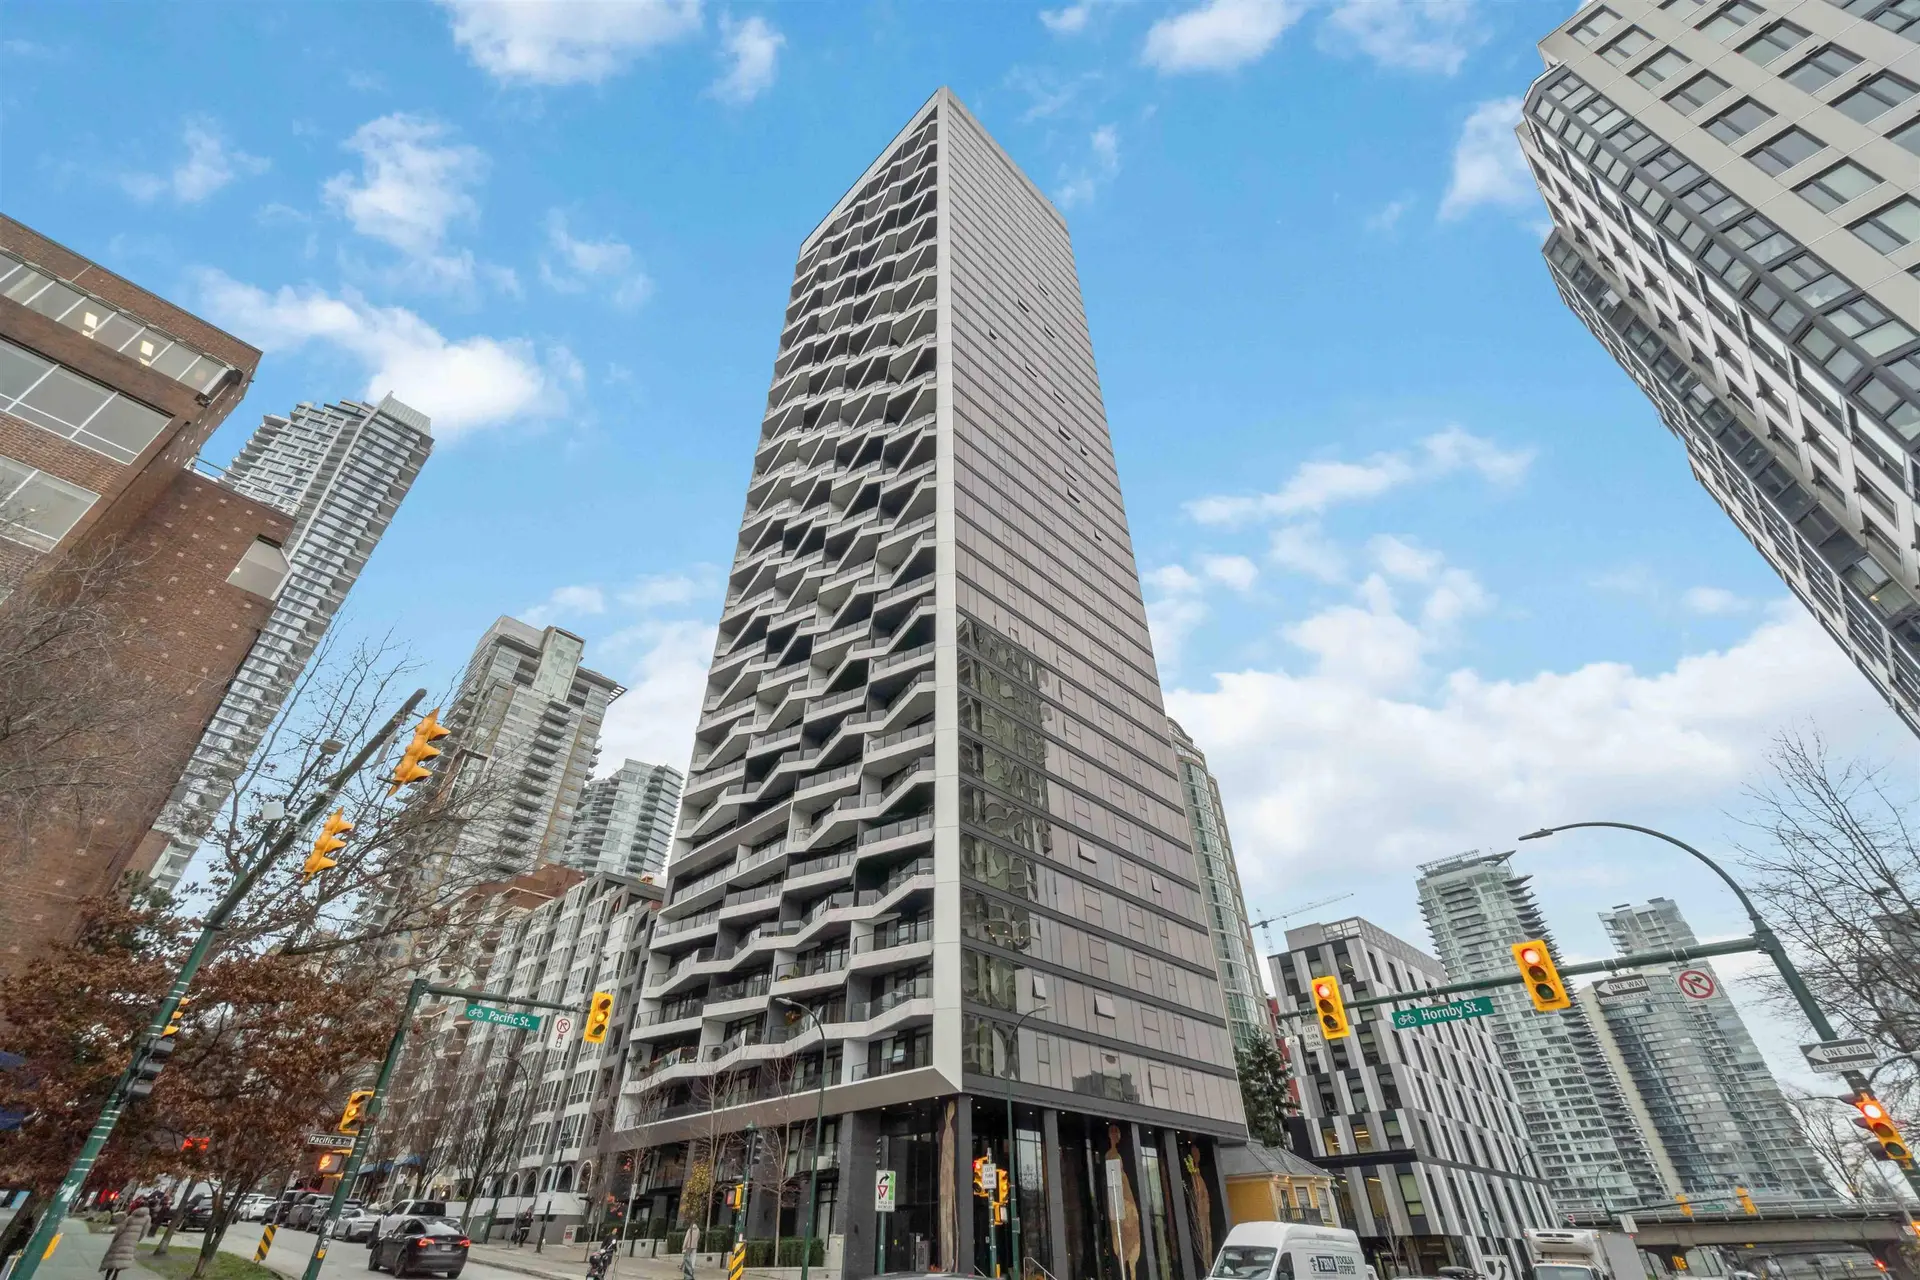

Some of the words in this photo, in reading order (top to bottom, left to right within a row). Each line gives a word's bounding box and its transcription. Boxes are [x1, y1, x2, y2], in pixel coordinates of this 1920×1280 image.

[1626, 980, 1644, 988] WAY
[1420, 1004, 1463, 1020] Hornby
[1464, 1001, 1482, 1014] St.
[488, 1010, 519, 1025] Pacific
[519, 1016, 531, 1027] St.
[1822, 1048, 1844, 1057] ONE
[1846, 1044, 1868, 1054] WAY
[310, 1136, 334, 1144] Pacific
